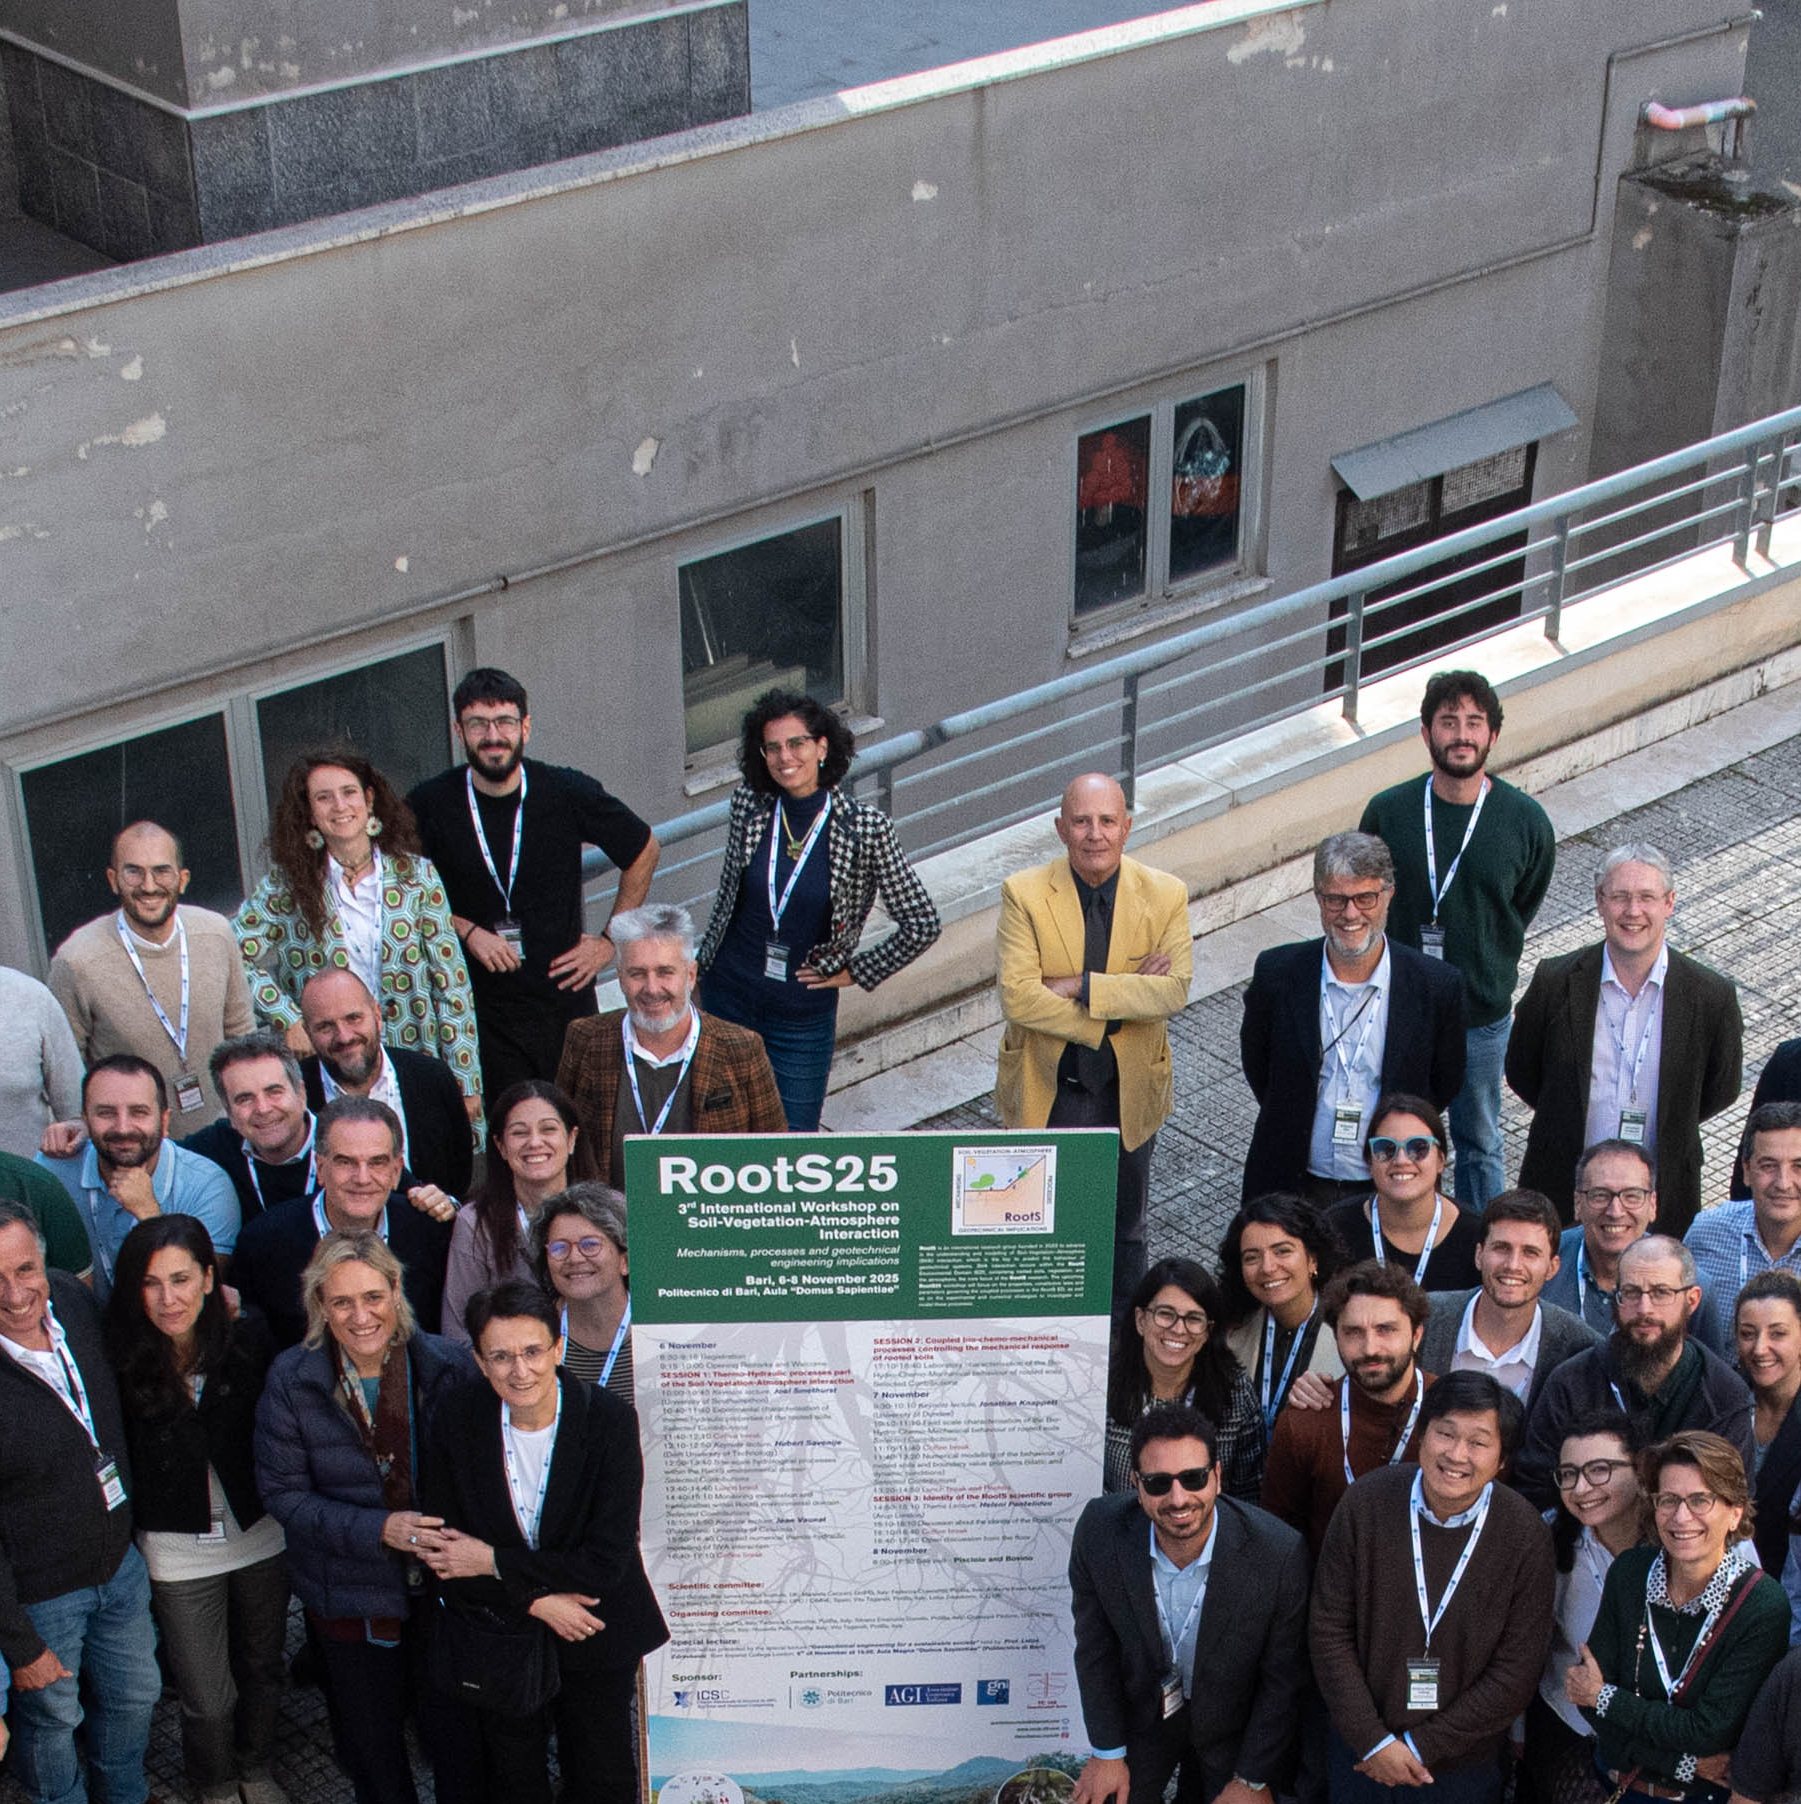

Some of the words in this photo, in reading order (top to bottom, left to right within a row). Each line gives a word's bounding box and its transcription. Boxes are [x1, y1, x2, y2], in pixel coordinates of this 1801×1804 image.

[659, 1154, 898, 1194] RootS25
[679, 1201, 696, 1214] 3rd
[701, 1201, 796, 1214] International
[800, 1200, 876, 1215] Workshop
[881, 1202, 899, 1211] on
[1005, 1211, 1041, 1222] RootS
[688, 1214, 899, 1230] Soil-Vegetation-Atmosphere
[820, 1229, 899, 1240] Interaction
[677, 1248, 747, 1258] Mechanisms,
[751, 1248, 805, 1259] processes
[809, 1246, 829, 1256] and
[832, 1245, 900, 1256] geotechnical
[771, 1258, 833, 1269] engineering
[836, 1257, 899, 1268] implications
[746, 1276, 775, 1286] Bari,
[779, 1275, 798, 1285] 6-8
[802, 1274, 866, 1285] November
[870, 1274, 899, 1283] 2025
[658, 1288, 720, 1297] Politecnico
[722, 1287, 732, 1296] di
[735, 1287, 761, 1297] Bari,
[763, 1287, 787, 1295] Aula
[791, 1286, 833, 1295] "Domus
[836, 1285, 899, 1295] Sapientiae"
[925, 1336, 960, 1345] Coupled
[918, 1344, 963, 1352] controlling
[789, 1370, 832, 1378] processes
[881, 1390, 929, 1398] November
[668, 1582, 710, 1590] Scientific
[669, 1610, 718, 1618] Organising
[671, 1639, 703, 1647] Special
[672, 1673, 722, 1682] Sponsor:
[790, 1670, 863, 1680] Partnerships:
[697, 1690, 730, 1700] ICSC
[827, 1689, 873, 1697] Politecnico
[888, 1687, 921, 1704] AGI
